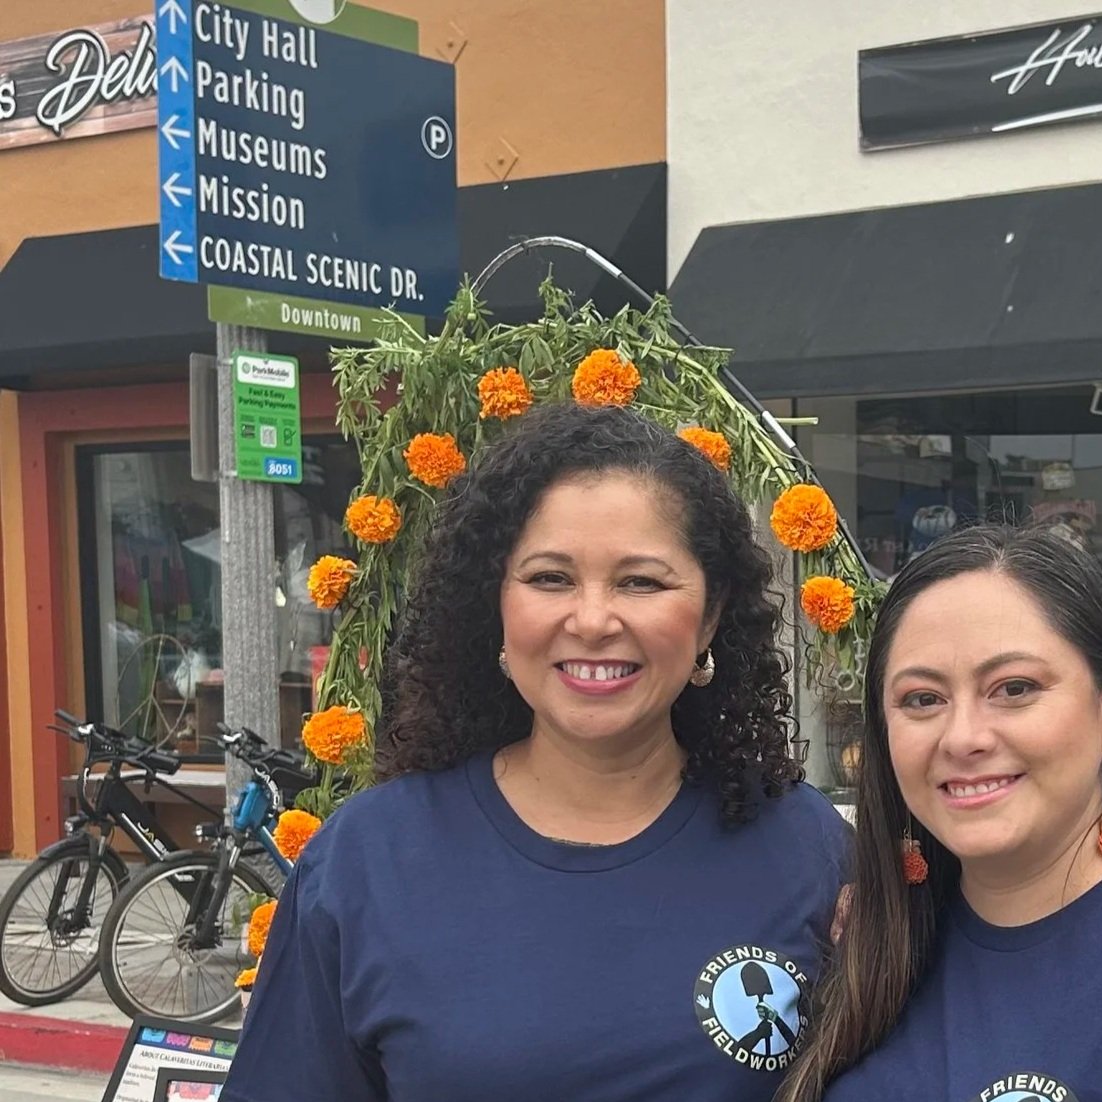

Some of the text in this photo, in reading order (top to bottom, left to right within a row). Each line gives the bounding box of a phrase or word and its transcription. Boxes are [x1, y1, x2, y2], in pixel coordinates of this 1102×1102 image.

[195, 4, 318, 69] City Hall
[196, 60, 306, 130] Parking
[197, 117, 327, 180] Museums
[198, 174, 305, 230] Mission
[200, 236, 424, 301] COASTAL SCENIC DR.
[281, 302, 362, 334] Downtown
[268, 462, 292, 476] 8051
[700, 946, 807, 984] FRIENDS OF
[980, 1074, 1067, 1102] FRIENDS
